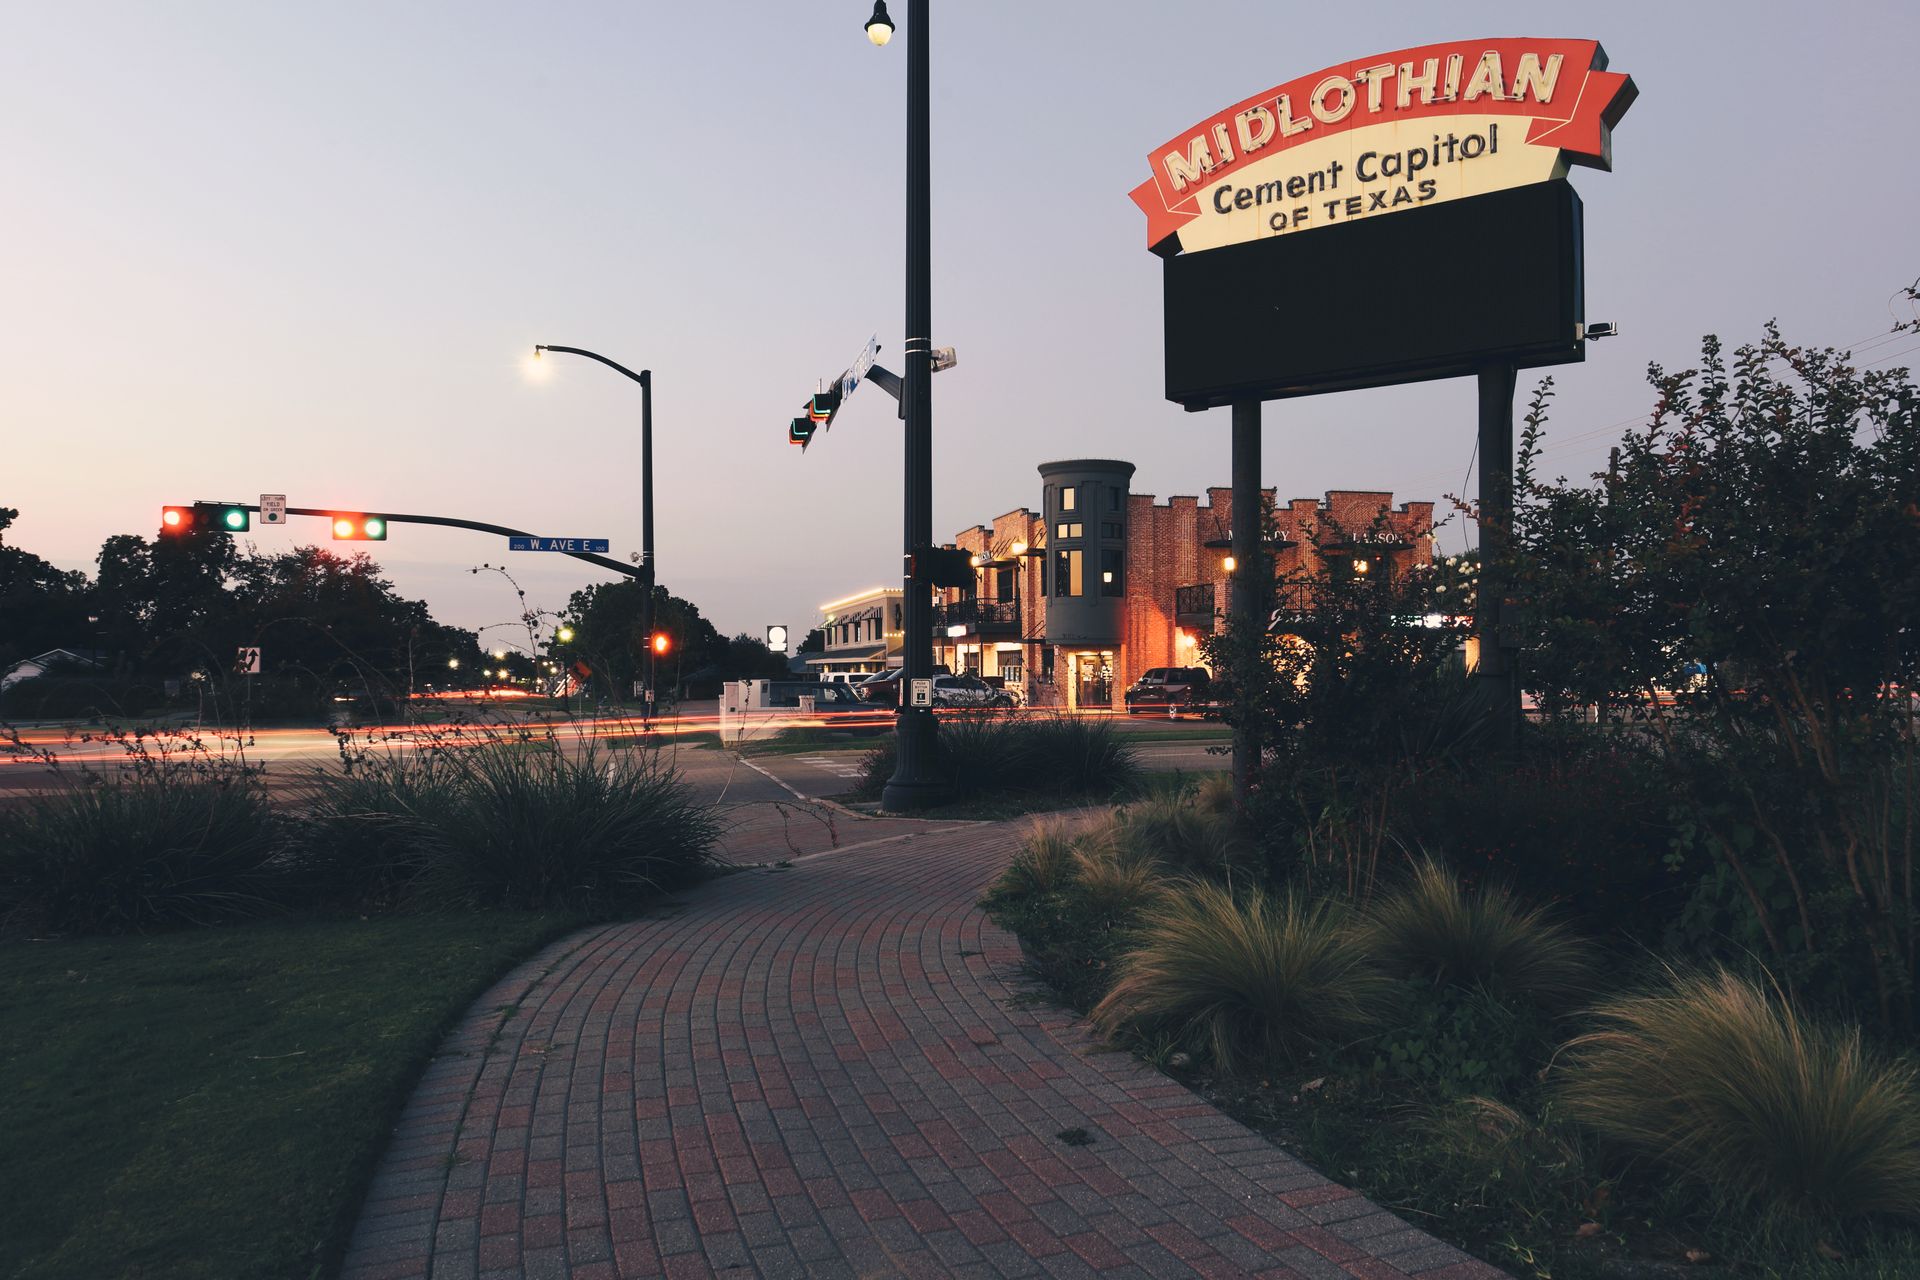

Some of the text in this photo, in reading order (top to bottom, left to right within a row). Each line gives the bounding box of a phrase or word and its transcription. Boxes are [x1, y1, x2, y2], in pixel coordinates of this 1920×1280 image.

[1163, 50, 1564, 192] MIDLOTHIAN
[1213, 124, 1498, 214] Cement Capitol
[1270, 179, 1437, 231] OF TEXAS
[530, 539, 591, 551] W. AVE E
